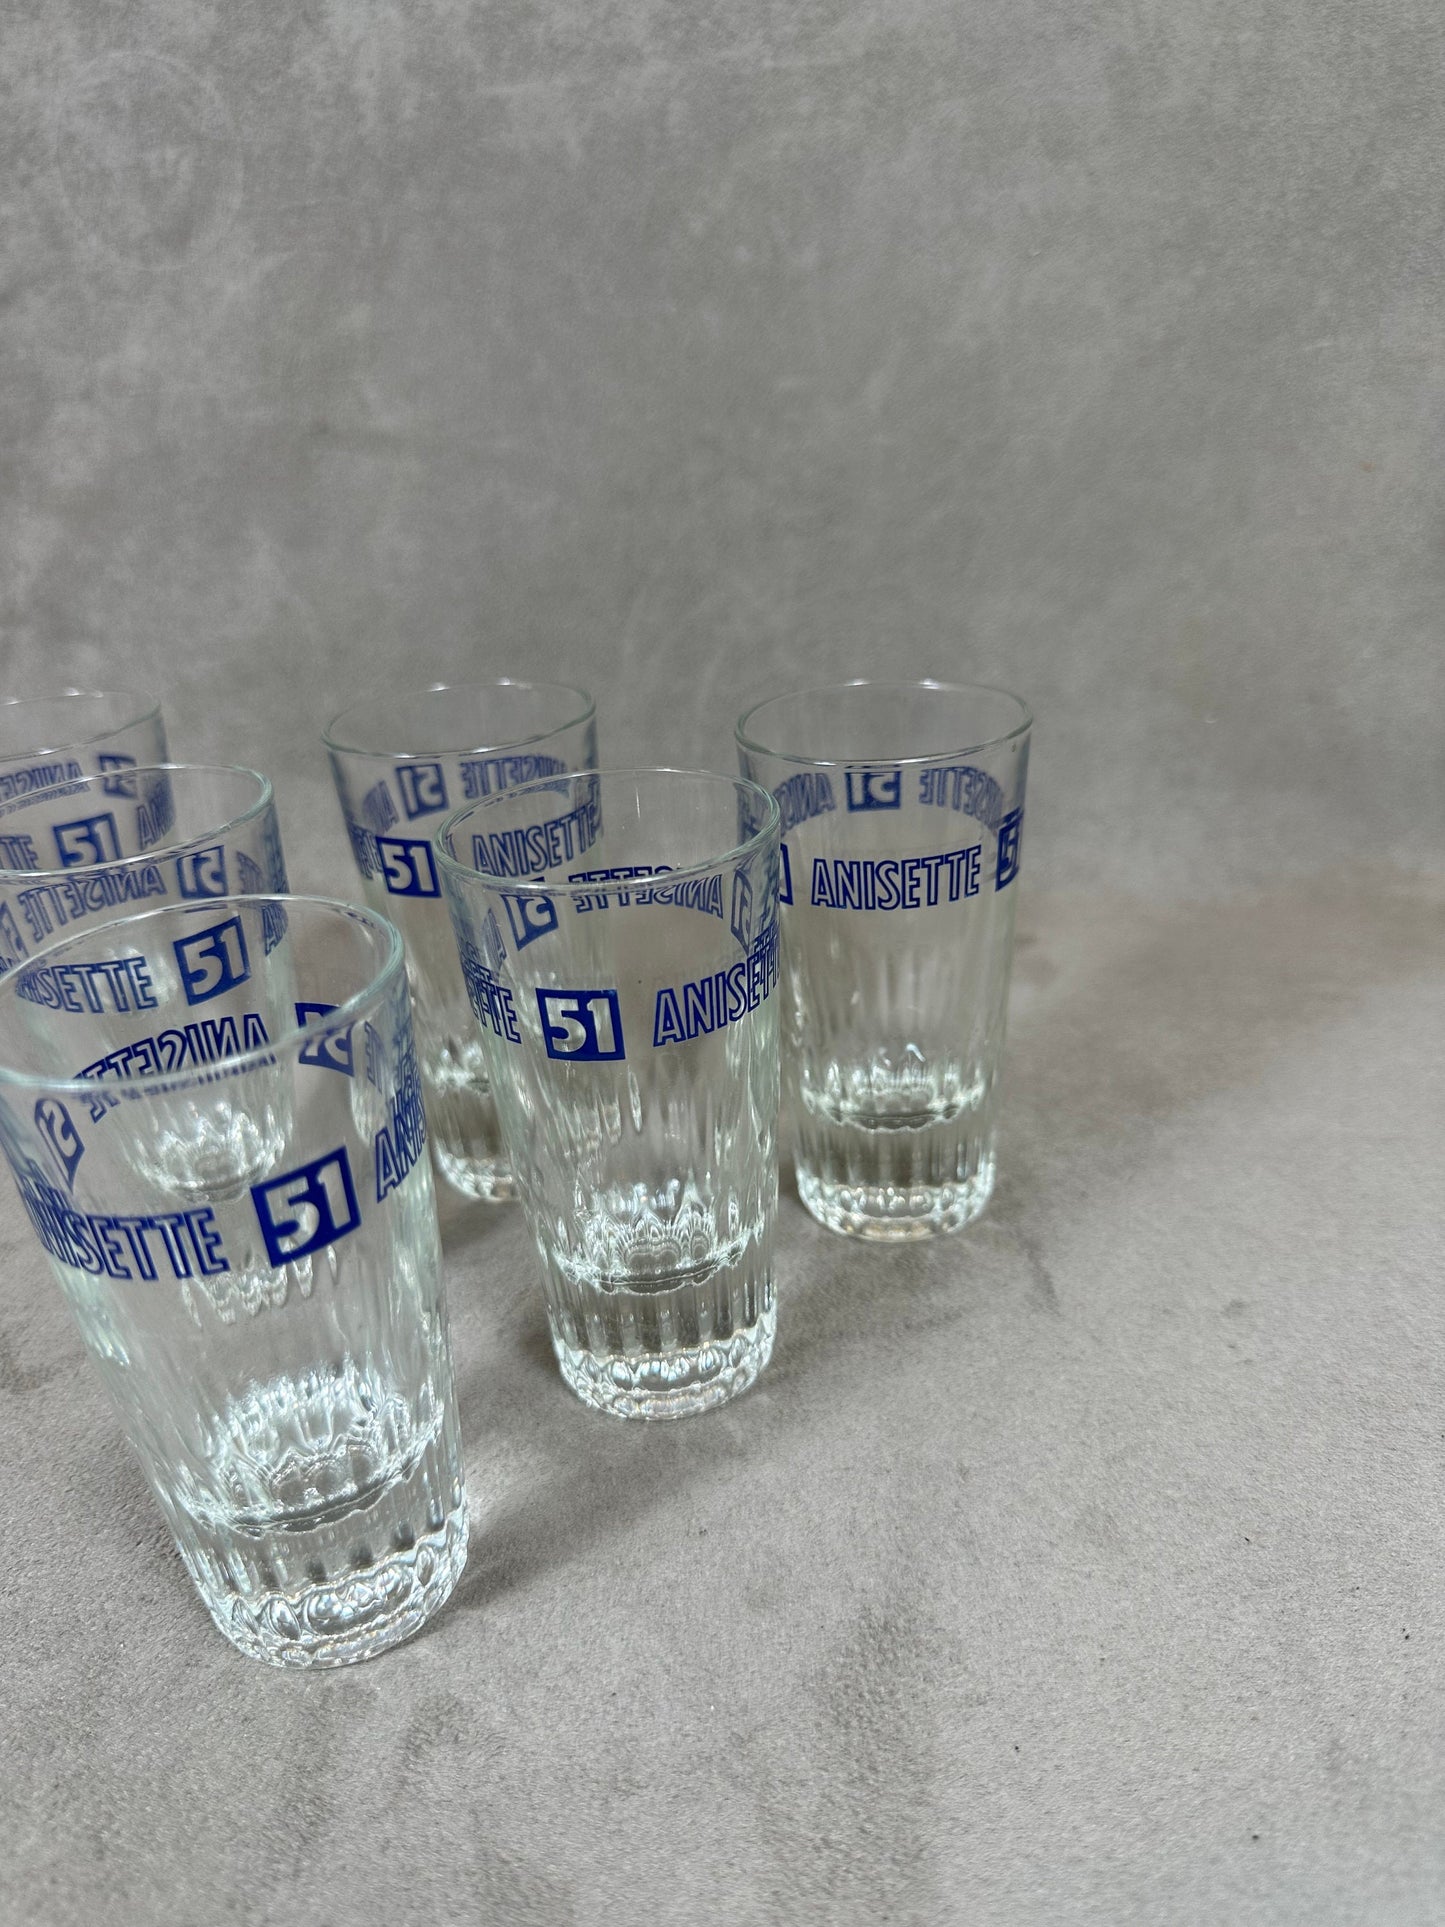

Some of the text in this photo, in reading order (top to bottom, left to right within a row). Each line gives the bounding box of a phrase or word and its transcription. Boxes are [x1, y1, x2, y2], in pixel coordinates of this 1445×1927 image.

[58, 818, 118, 866] 51
[381, 842, 436, 894] 51
[811, 844, 982, 910] ANISETTE
[182, 924, 246, 998] 51
[544, 996, 617, 1054] 51
[264, 1160, 352, 1254] 51
